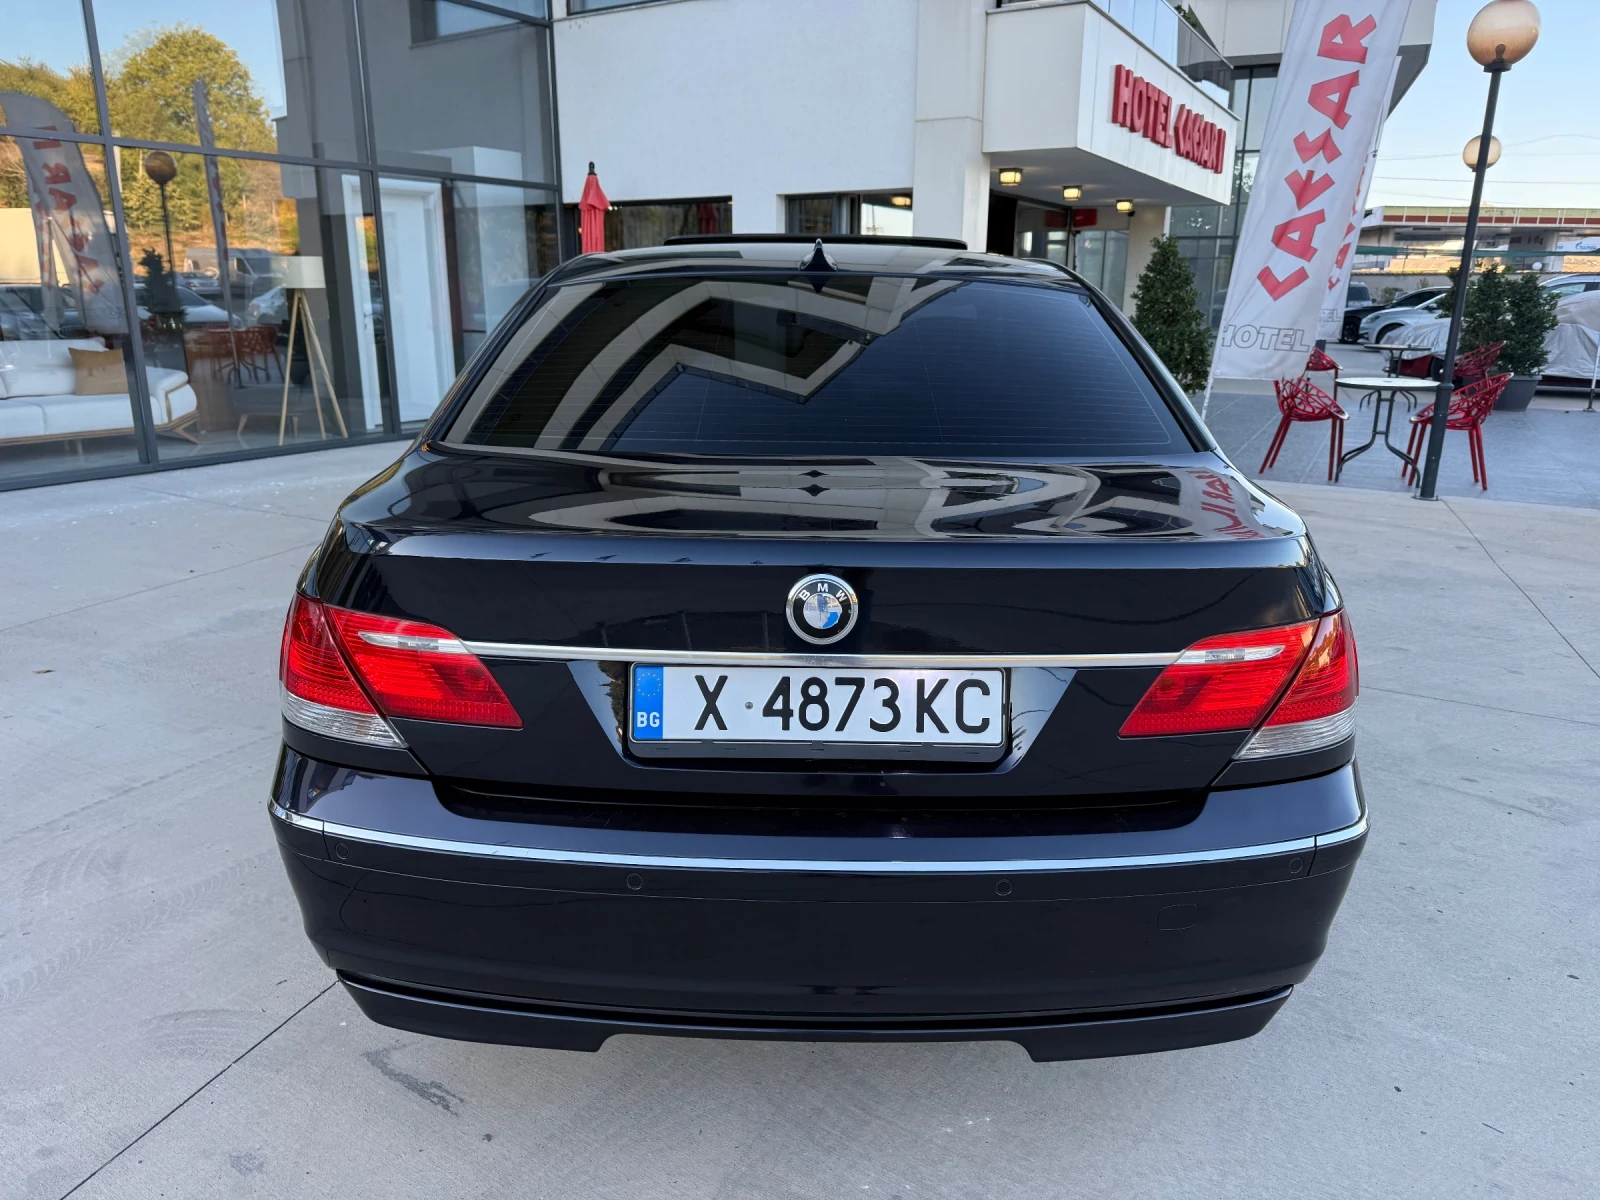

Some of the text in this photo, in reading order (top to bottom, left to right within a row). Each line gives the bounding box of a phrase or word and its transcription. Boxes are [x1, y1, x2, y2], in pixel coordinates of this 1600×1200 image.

[1112, 64, 1173, 149] HOTEL
[1222, 324, 1310, 352] HOTEL
[799, 582, 848, 603] BMW
[694, 675, 991, 734] X 4873 KC
[636, 711, 660, 728] BG
